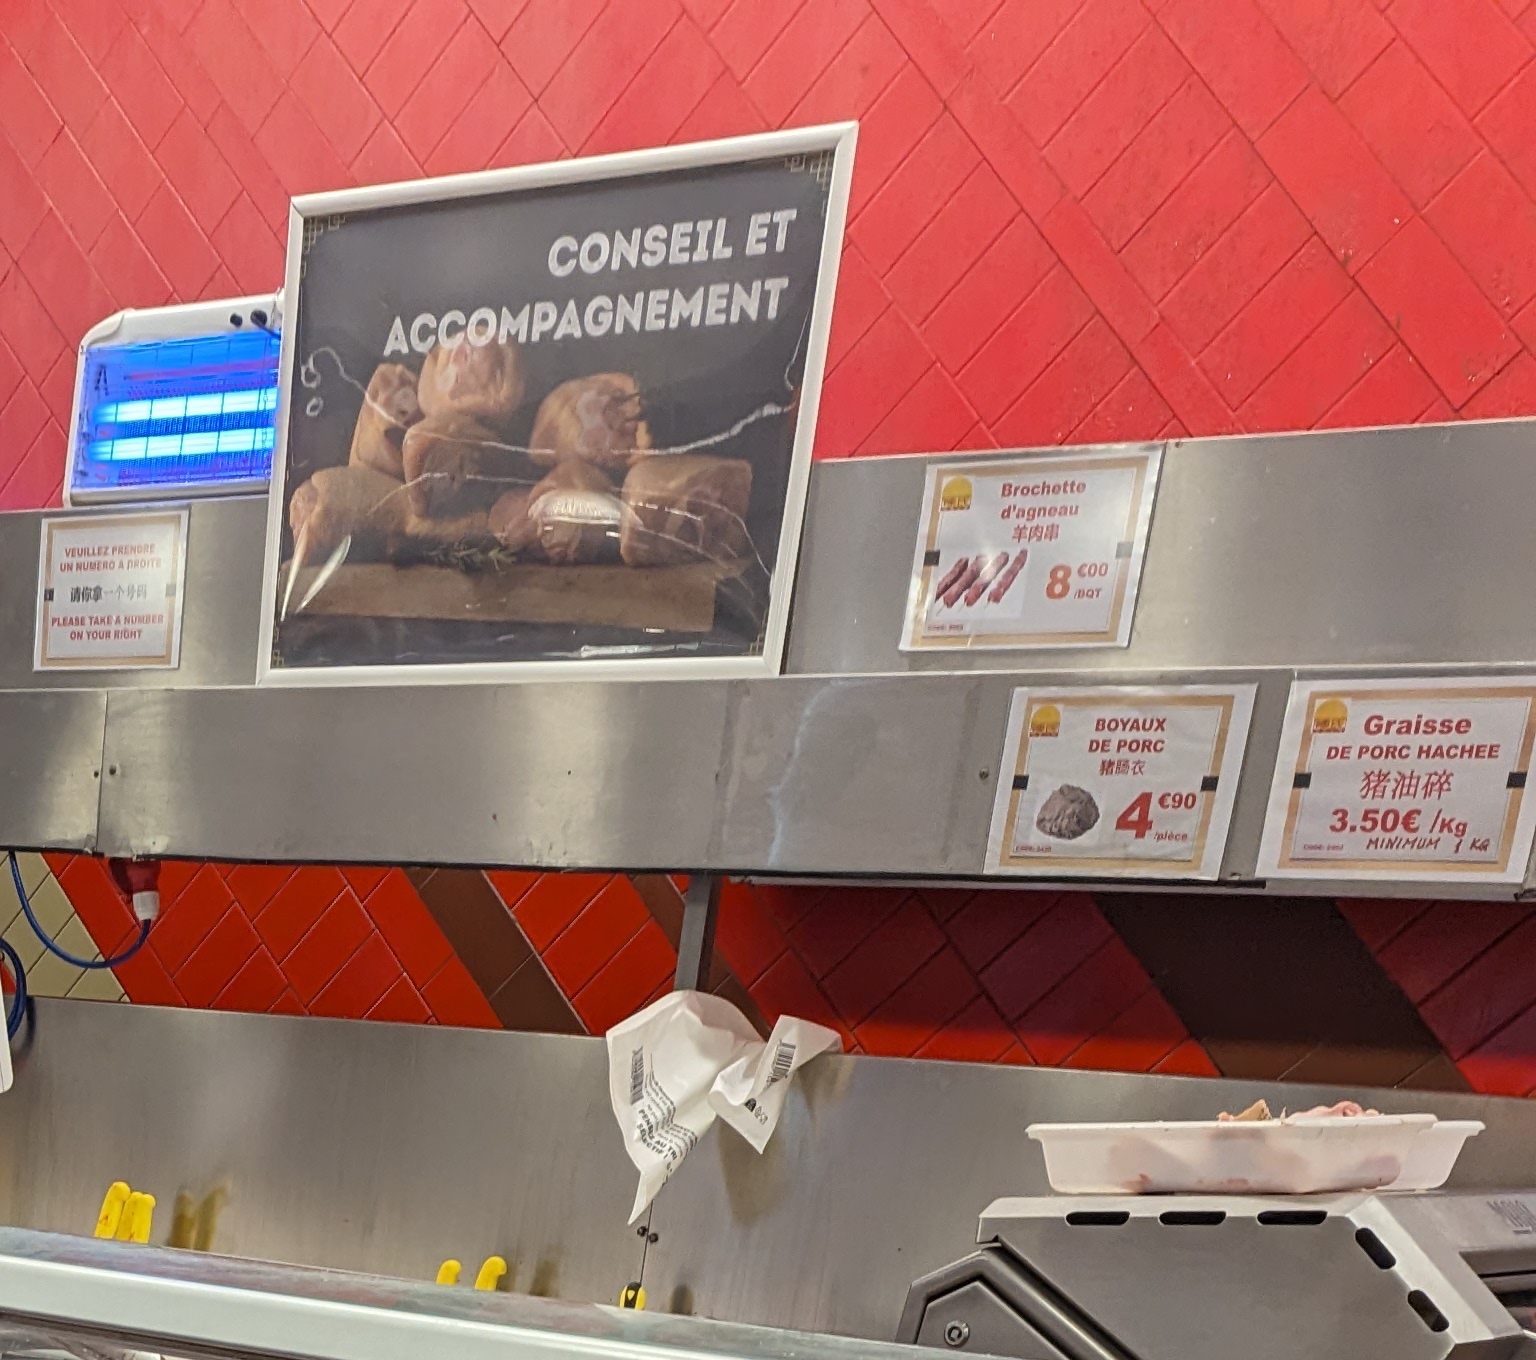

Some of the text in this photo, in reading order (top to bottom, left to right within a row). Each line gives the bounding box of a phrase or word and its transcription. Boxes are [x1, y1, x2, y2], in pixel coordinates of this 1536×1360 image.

[547, 208, 797, 278] CONSEIL ET
[383, 277, 790, 358] ACCOMPAGNEMENT
[1001, 479, 1087, 498] Brochette
[1000, 504, 1080, 521] d'agneau
[1012, 523, 1060, 542] 羊肉串
[64, 544, 155, 558] VEUILLEZ PRENDRE
[60, 558, 162, 572] UN NUMERO A DROITE
[1045, 564, 1072, 600] 8
[51, 614, 164, 627] PLEASE TAKE A NUMBER
[70, 629, 143, 641] ON YOUR RIGHT
[1094, 718, 1167, 732] BOYAUX
[1363, 714, 1472, 736] Graisse
[1088, 738, 1166, 753] DE PORC
[1326, 744, 1501, 760] DE PORC HACHEE
[1360, 768, 1454, 800] 猪油碎
[1115, 792, 1197, 840] 4 €90
[1329, 808, 1422, 834] 3.50€
[1366, 837, 1441, 851] MINIMUM
